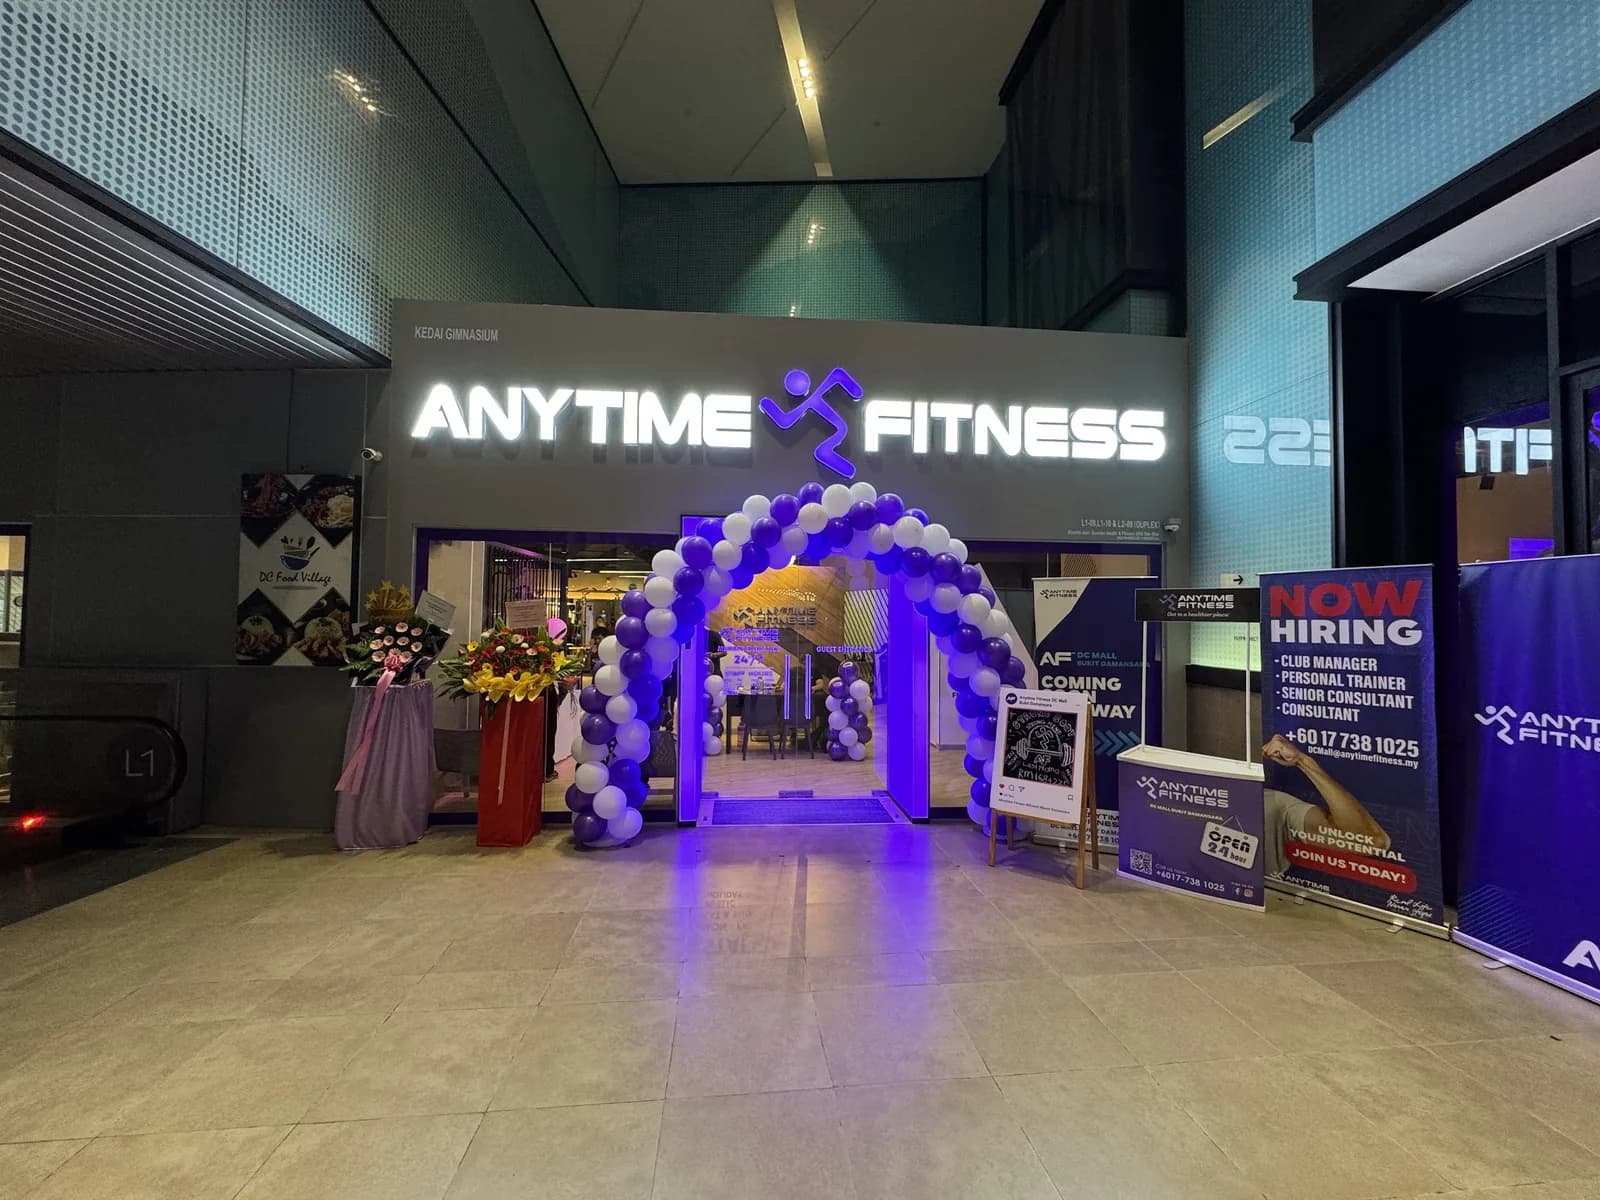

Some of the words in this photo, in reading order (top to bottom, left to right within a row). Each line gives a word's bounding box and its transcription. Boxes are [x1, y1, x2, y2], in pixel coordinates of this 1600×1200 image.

[414, 326, 443, 339] KEDAI
[445, 327, 499, 341] GIMNASIUM
[411, 384, 752, 449] ANYTIME
[864, 400, 1166, 462] FITNESS
[259, 571, 274, 582] DC
[276, 571, 299, 582] Food
[301, 571, 332, 587] Village
[1178, 594, 1234, 602] ANYTIME
[1269, 580, 1423, 618] NOW
[1270, 619, 1423, 646] HIRING
[1040, 651, 1072, 666] AF
[1091, 652, 1117, 660] MALL
[1281, 655, 1311, 668] CLUB
[1313, 656, 1378, 671] MANAGER
[1041, 675, 1122, 691] COMING
[1282, 671, 1345, 687] PERSONAL
[1346, 674, 1406, 690] TRAINER
[1282, 687, 1325, 702] SENIOR
[1327, 690, 1414, 709] CONSULTANT
[1282, 703, 1360, 722] CONSULTANT
[1285, 728, 1317, 745] +60
[1320, 730, 1337, 747] 17
[1340, 733, 1372, 751] 738
[1375, 737, 1420, 758] 1025
[125, 749, 153, 776] L1
[1307, 745, 1419, 769] DCMall@anytimefitness.my
[1159, 780, 1229, 799] ANYTIME
[1159, 789, 1229, 809] FITNESS
[1208, 831, 1251, 853] OPEN
[1290, 829, 1327, 845] YOUR
[1327, 838, 1406, 862] POTENTIAL
[1318, 825, 1374, 845] UNLOCK
[1207, 842, 1229, 857] 24
[1230, 852, 1247, 864] hour
[1291, 848, 1326, 864] JOIN
[1327, 856, 1346, 869] US
[1348, 861, 1407, 884] TODAY!
[1156, 870, 1201, 887] +6017-738
[1203, 880, 1225, 892] 1025
[1285, 875, 1331, 892] ANYTIME
[1562, 939, 1600, 970] A
